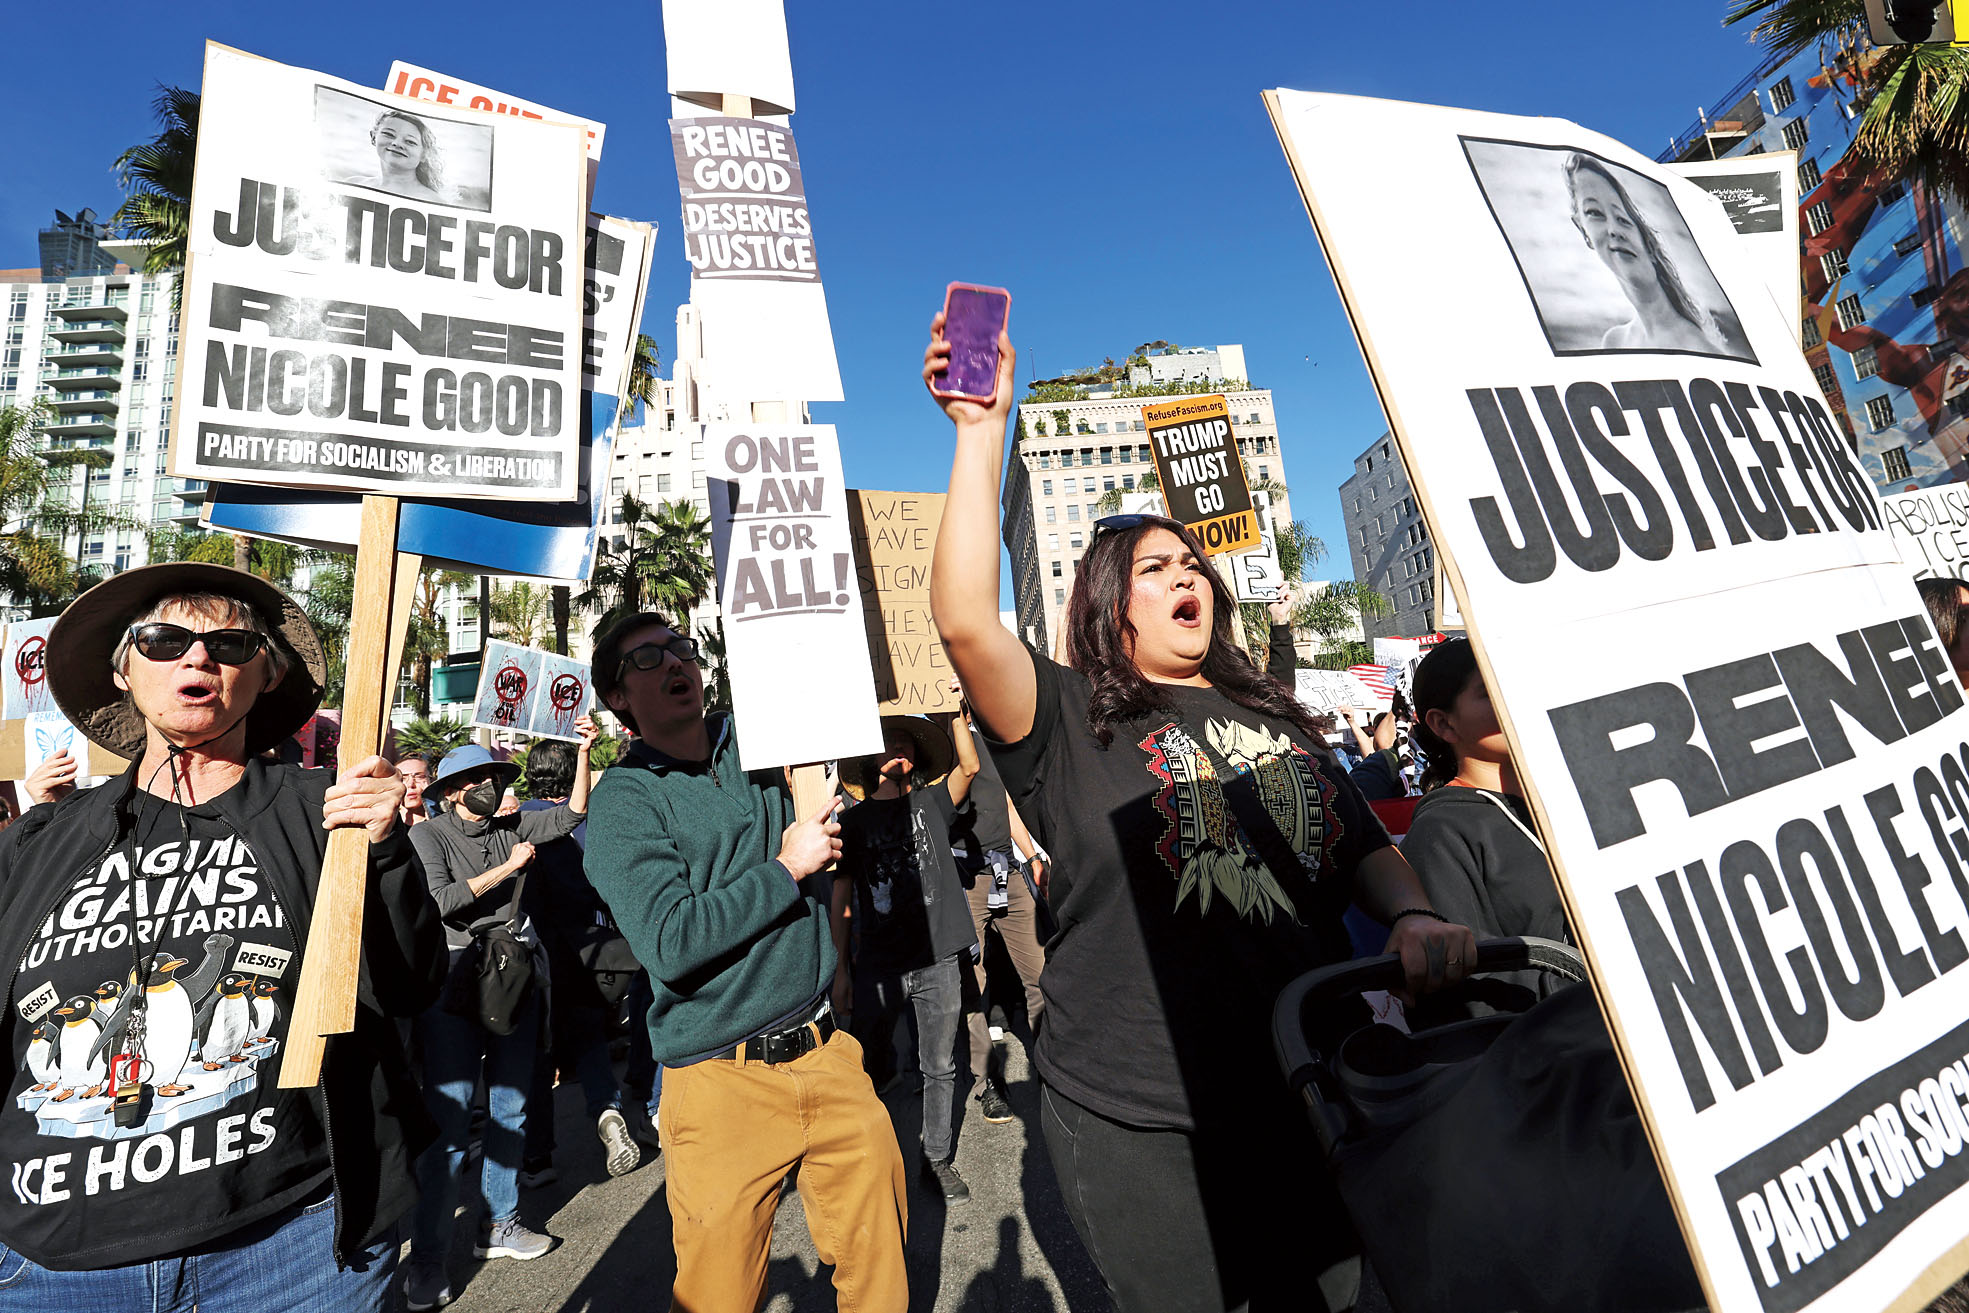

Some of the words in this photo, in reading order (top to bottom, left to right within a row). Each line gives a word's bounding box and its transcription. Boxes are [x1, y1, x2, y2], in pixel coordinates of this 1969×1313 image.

[682, 125, 790, 162] RENEE
[693, 159, 790, 192] GOOD
[213, 178, 456, 280] JUTICE
[464, 220, 562, 296] FOR
[686, 203, 810, 236] DESERVES
[691, 234, 816, 271] JUSTICE
[209, 282, 563, 370] RENEE
[203, 340, 410, 427] NICOLE
[423, 368, 562, 437] GOOD
[1147, 402, 1224, 422] RefuseFascism.org
[725, 435, 818, 473] ONE
[1153, 419, 1228, 457] TRUMP
[204, 433, 274, 462] PARTY
[277, 438, 316, 465] FOR
[320, 442, 424, 475] SOCIALISM
[427, 453, 452, 475] &
[456, 453, 555, 481] LIBERATION
[1170, 451, 1229, 487] MUST
[727, 477, 824, 514] LAW
[1195, 483, 1225, 514] GO
[1465, 377, 1812, 584] JUSTICE
[1757, 385, 1884, 533] FOR
[867, 498, 918, 520] WE
[1884, 489, 1969, 539] ABOLISH
[749, 524, 817, 552] FOR
[855, 525, 928, 553] HAVE
[1917, 530, 1969, 567] ICE
[731, 553, 850, 615] ALL!
[856, 565, 930, 594] SIGN
[864, 609, 932, 635] HEY
[499, 674, 524, 694] WAR
[554, 683, 580, 701] ICE
[877, 680, 951, 707] UNS.
[495, 707, 516, 721] OIL
[1546, 614, 1964, 850] RENEE
[237, 951, 287, 972] RESIST
[1615, 783, 1969, 1114] NICOLE
[21, 988, 55, 1018] RESIST
[11, 1152, 72, 1205] ICE
[85, 1107, 277, 1196] HOLES
[1737, 1138, 1867, 1288] PARTY
[1843, 1102, 1926, 1213] FOR
